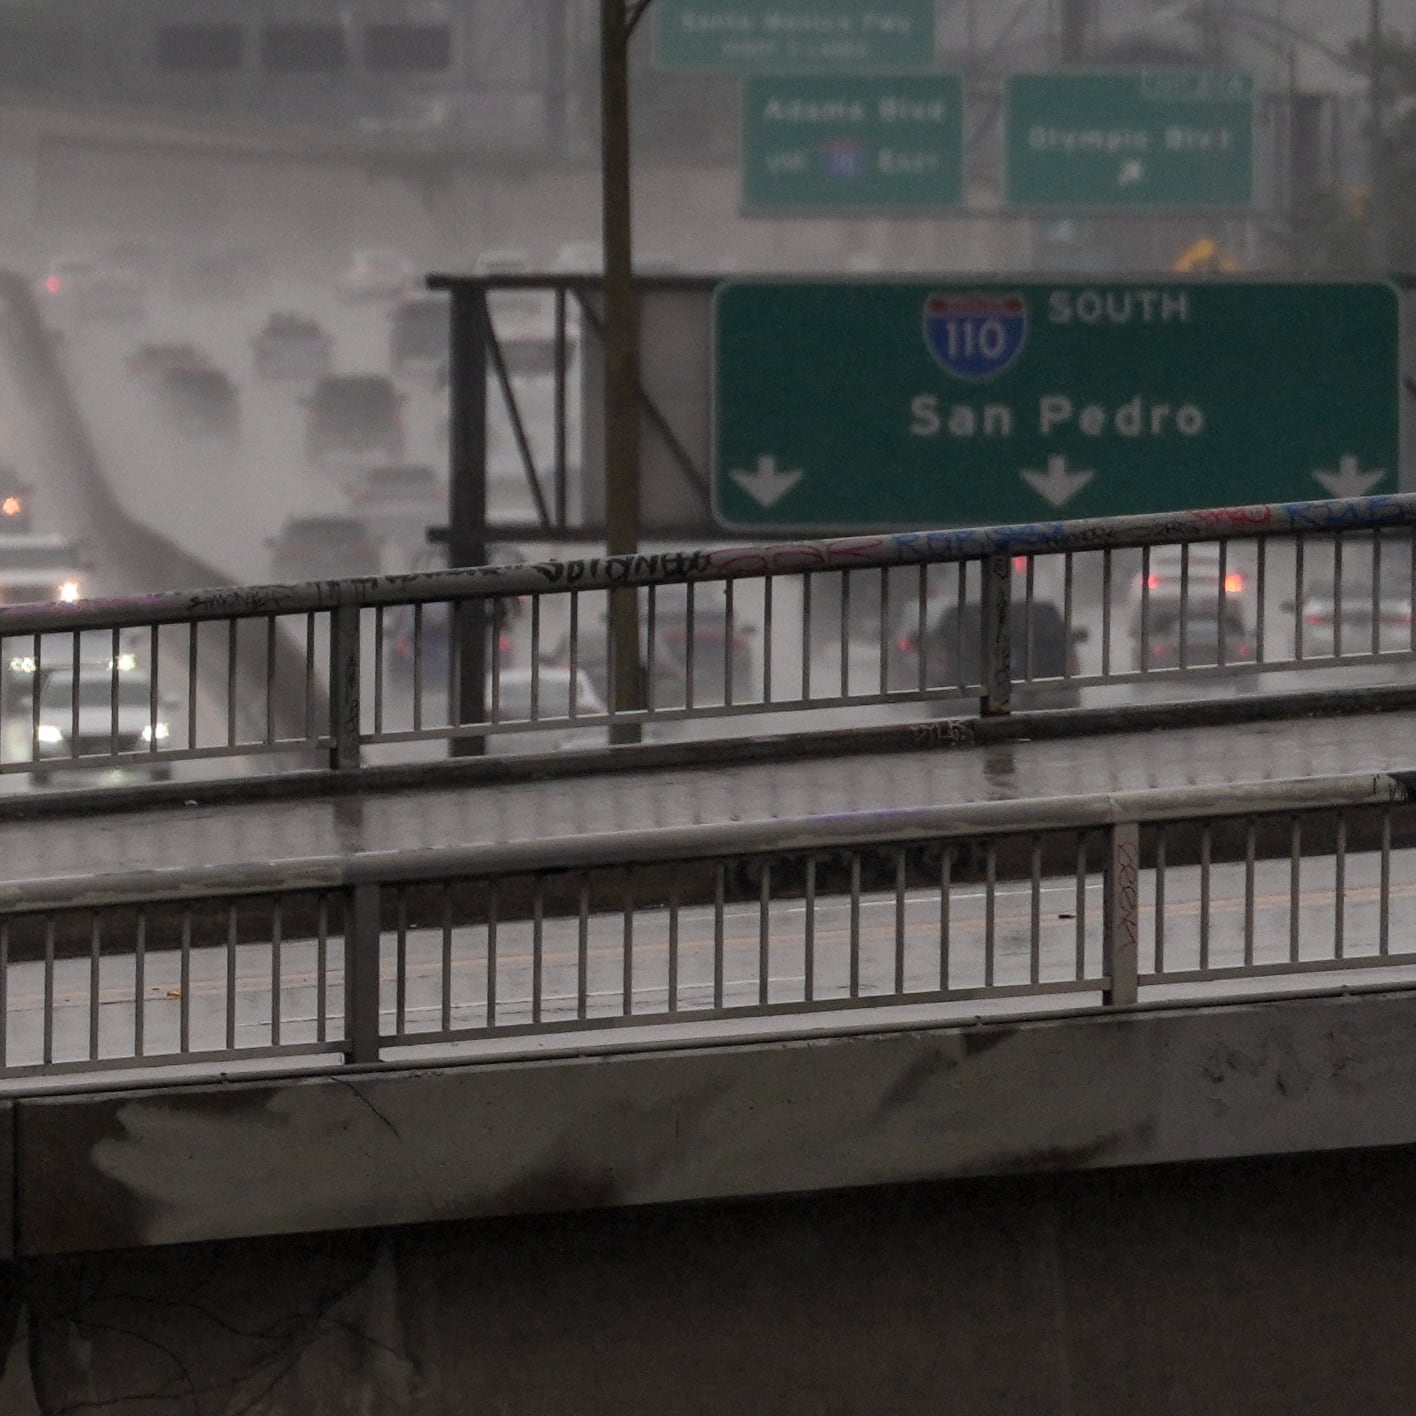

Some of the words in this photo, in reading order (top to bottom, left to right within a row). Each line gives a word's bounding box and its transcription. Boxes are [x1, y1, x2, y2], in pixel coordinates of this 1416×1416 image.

[944, 320, 1007, 360] 110
[1048, 292, 1190, 325] SOUTH
[910, 395, 1011, 438] San
[1039, 395, 1206, 439] Pedro
